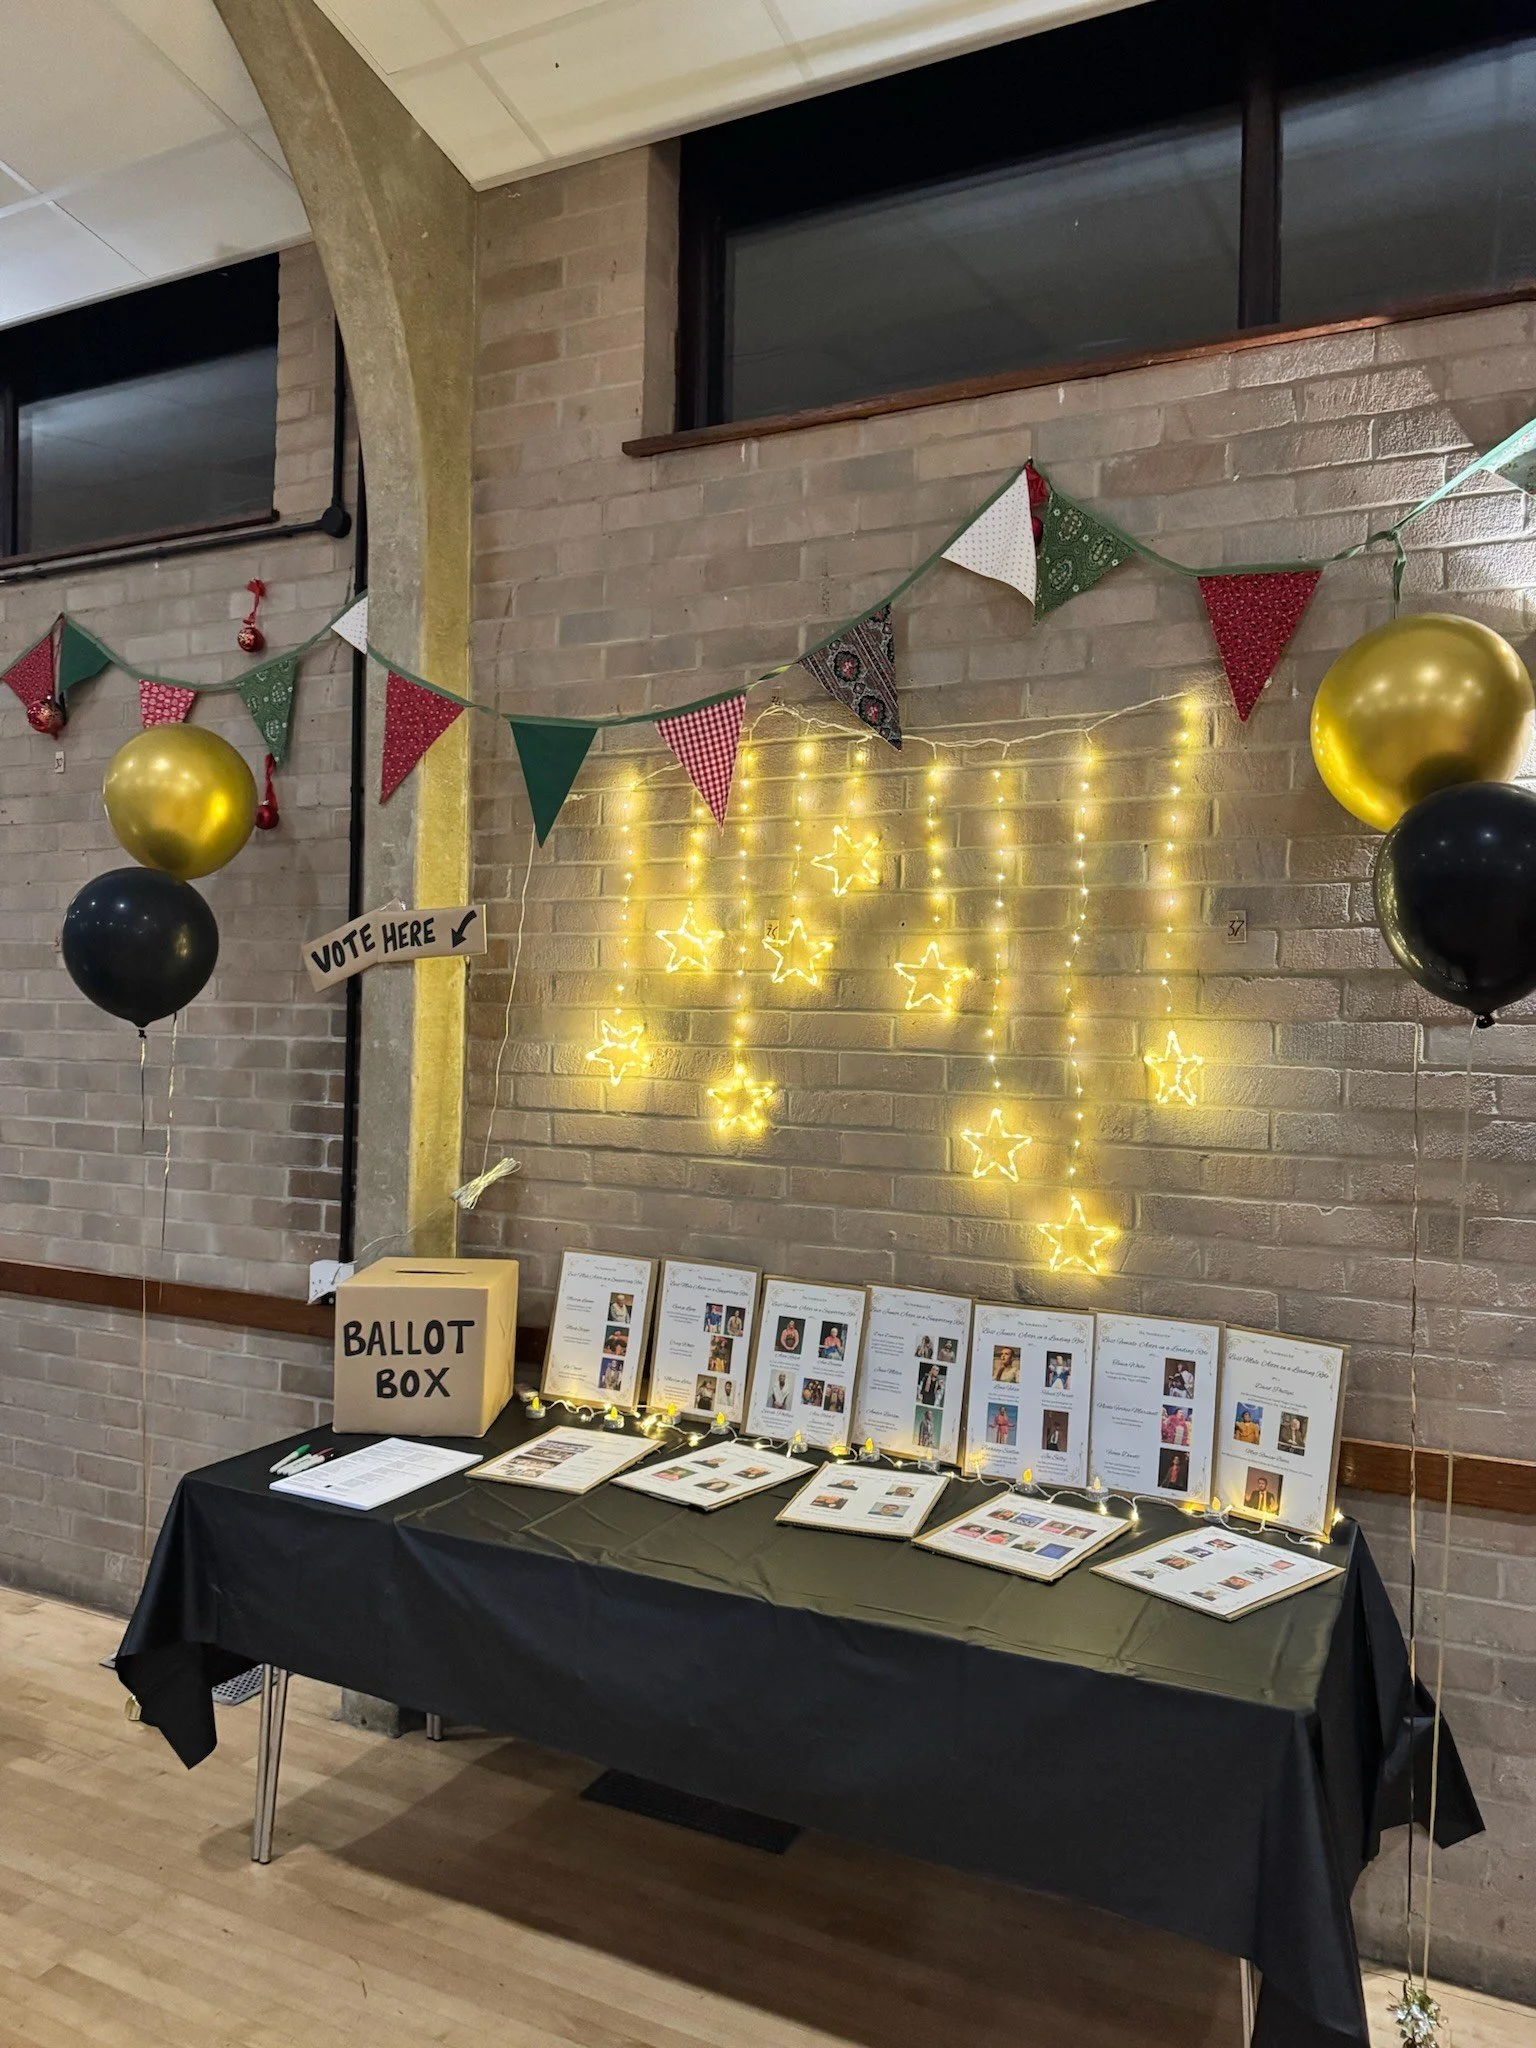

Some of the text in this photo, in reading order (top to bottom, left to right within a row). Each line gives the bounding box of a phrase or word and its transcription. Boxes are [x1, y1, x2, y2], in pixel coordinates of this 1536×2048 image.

[311, 917, 436, 974] VOTE HERE
[1228, 920, 1245, 937] 37
[343, 1320, 475, 1356] BALLOT
[376, 1367, 450, 1399] BOX
